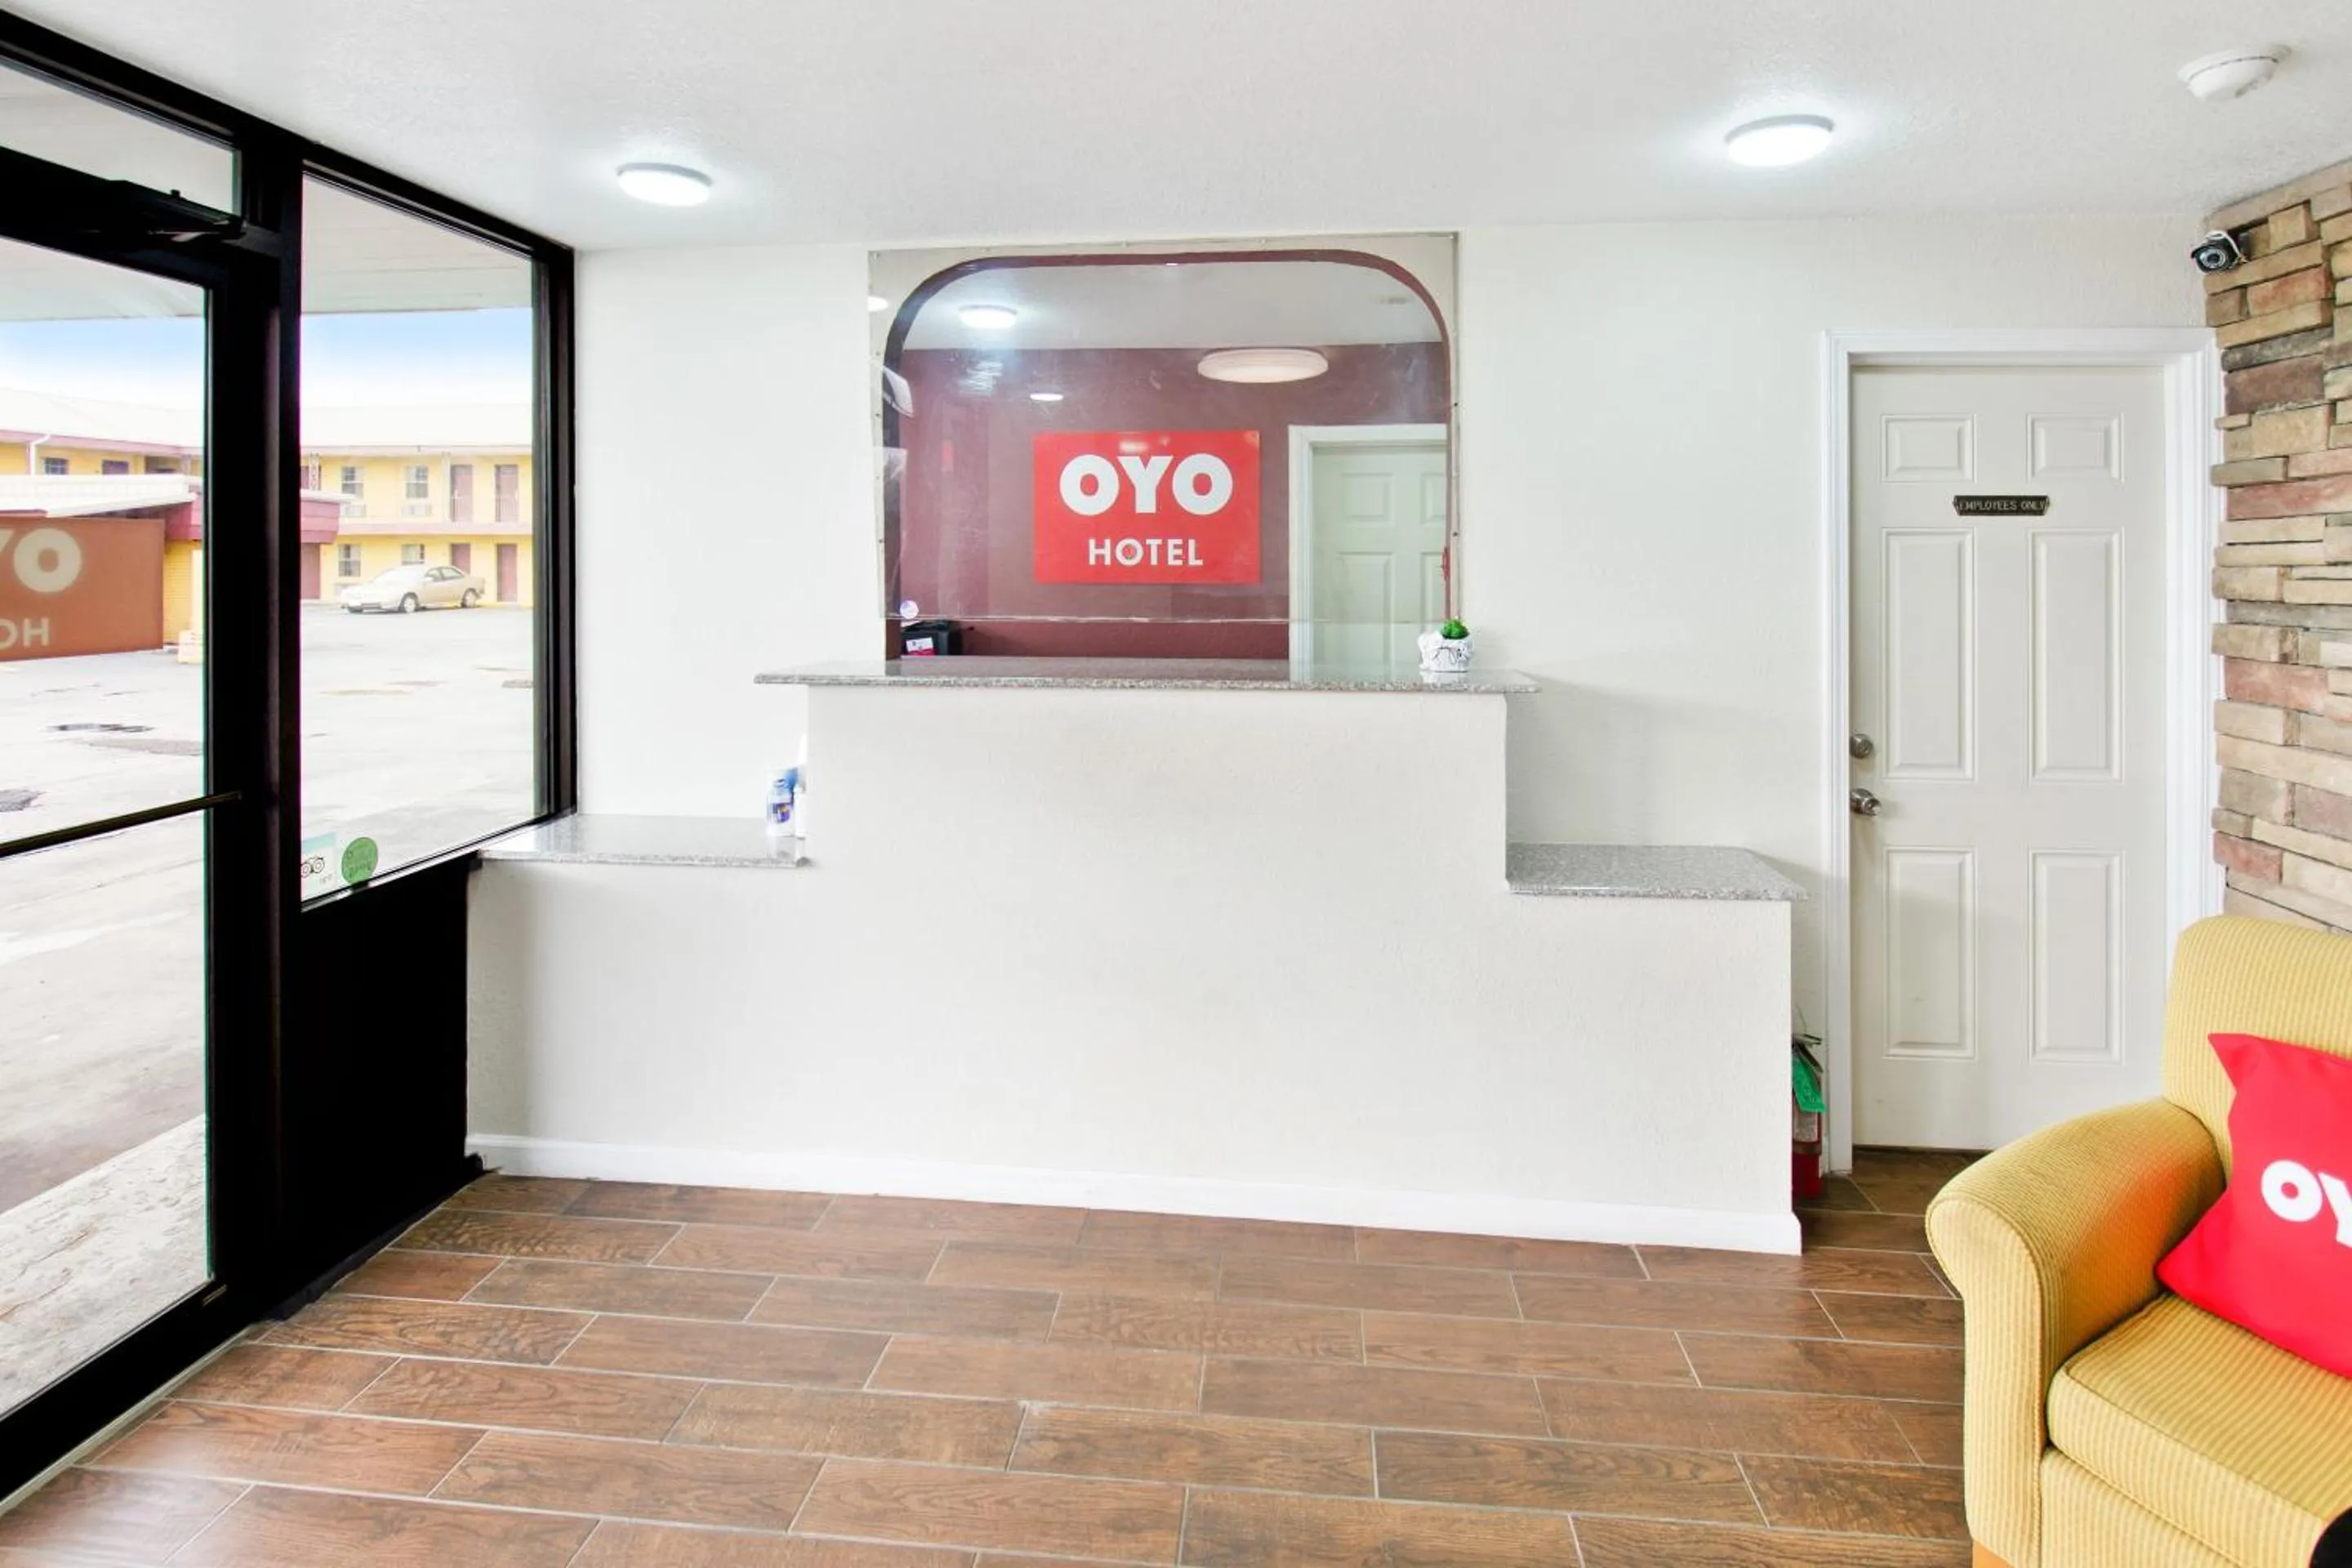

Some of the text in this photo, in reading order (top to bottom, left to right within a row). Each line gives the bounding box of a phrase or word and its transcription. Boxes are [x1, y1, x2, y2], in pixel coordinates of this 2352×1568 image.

[1059, 453, 1233, 515] OYO
[1959, 500, 2046, 510] EMPLOYEES ONLY
[1088, 538, 1204, 567] HOTEL
